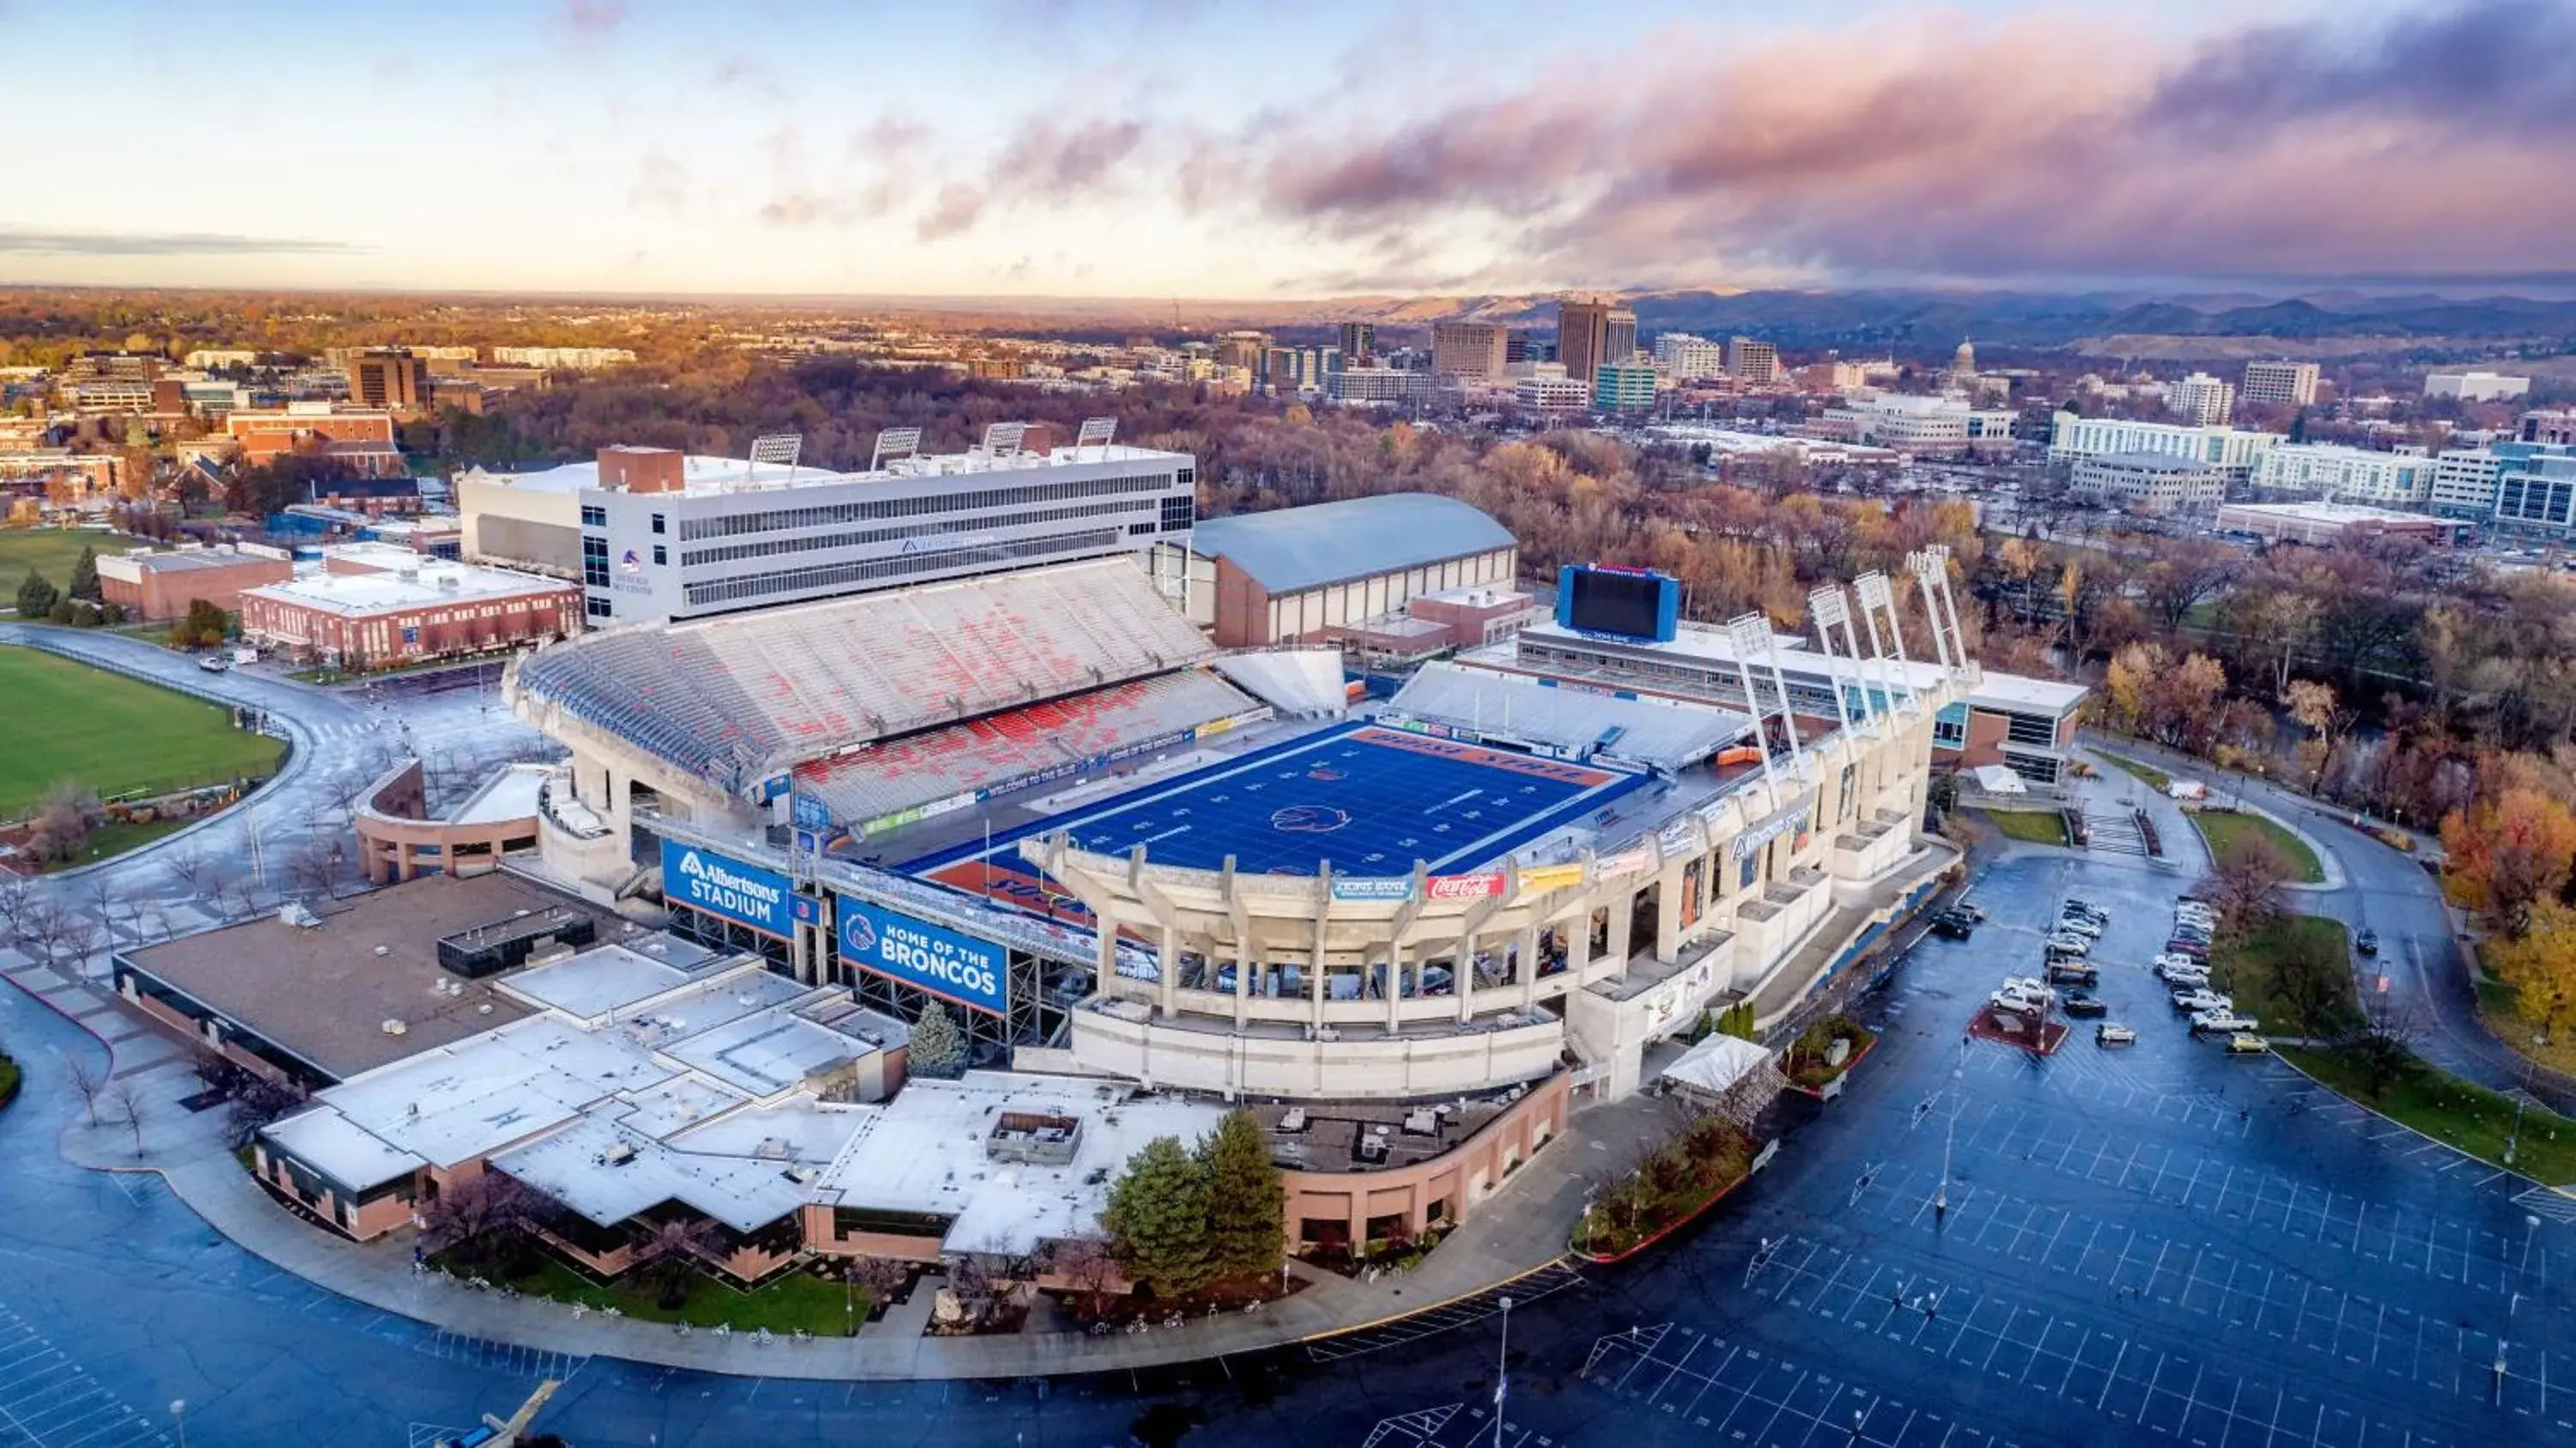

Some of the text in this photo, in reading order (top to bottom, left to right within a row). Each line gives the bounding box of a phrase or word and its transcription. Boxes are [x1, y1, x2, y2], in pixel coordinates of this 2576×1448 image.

[690, 879, 772, 923] STADIUM
[706, 864, 781, 904] Albertsons
[880, 936, 997, 996] BRONCOS
[886, 923, 989, 970] HOME OF THE
